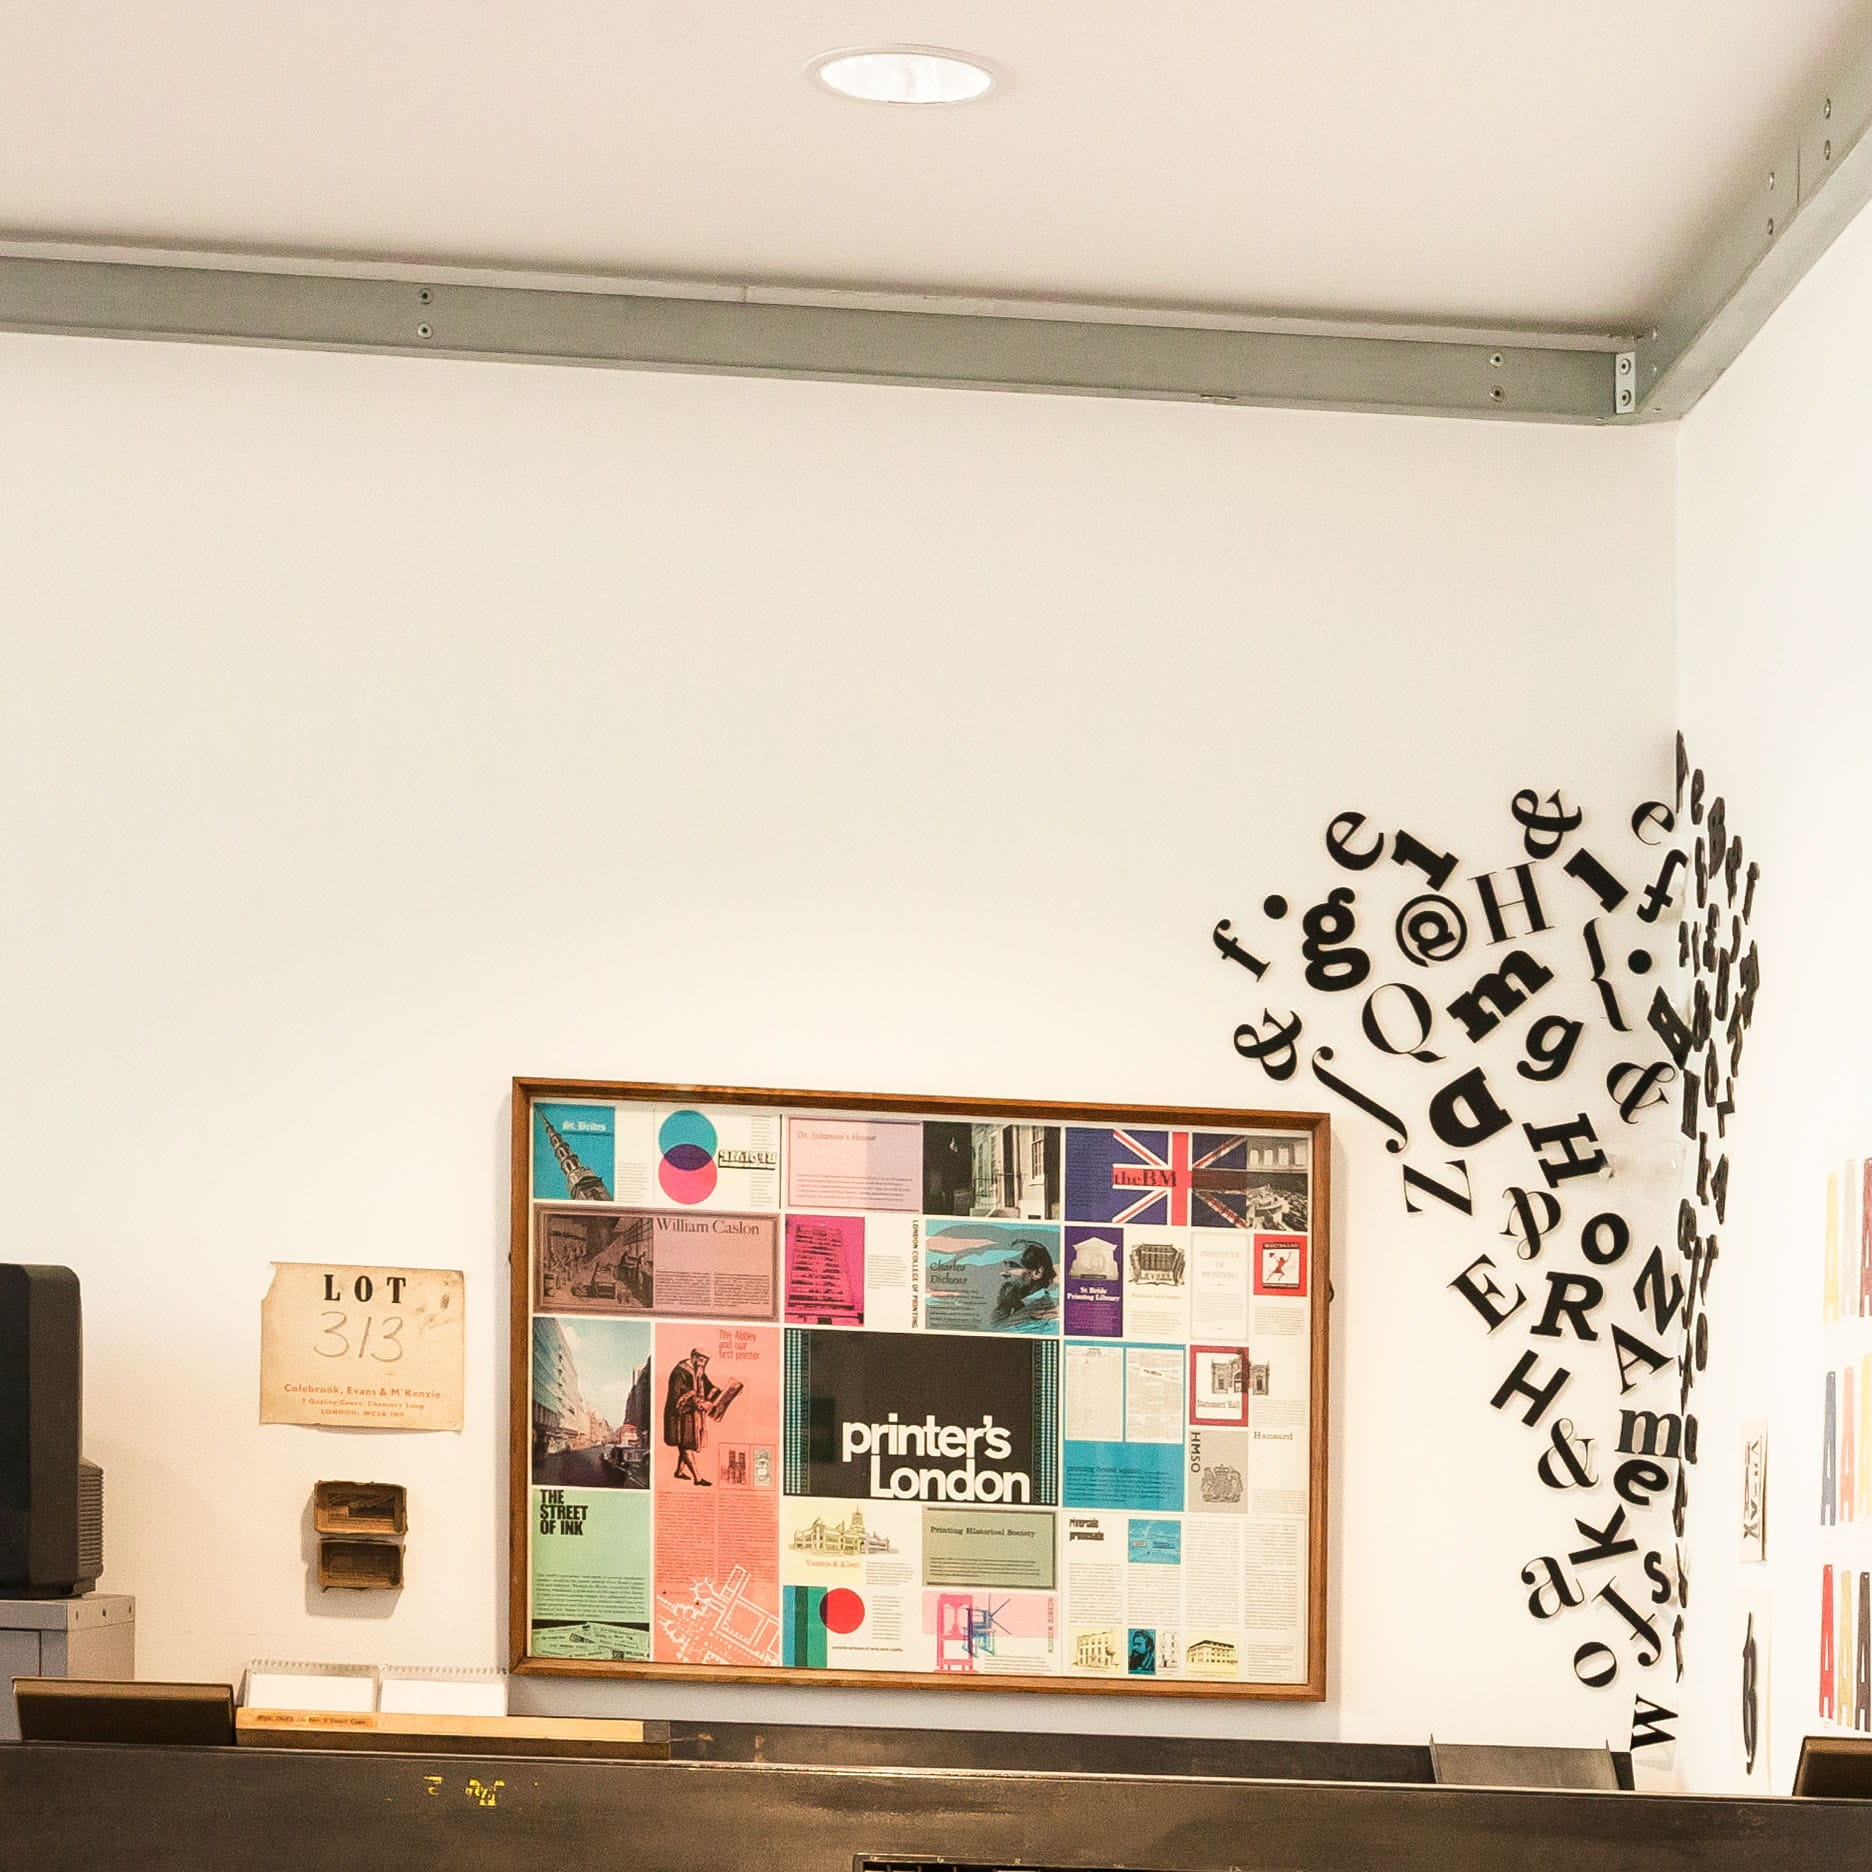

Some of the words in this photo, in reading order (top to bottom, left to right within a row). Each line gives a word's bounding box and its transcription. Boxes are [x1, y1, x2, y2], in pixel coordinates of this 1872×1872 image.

[656, 1217, 710, 1233] William
[712, 1219, 761, 1236] Caslon
[929, 1262, 967, 1273] Charles
[929, 1273, 968, 1285] Dickens
[323, 1273, 407, 1304] LOT
[314, 1311, 404, 1363] 313
[347, 1386, 376, 1397] Evans
[379, 1386, 387, 1397] &
[841, 1412, 1013, 1463] printer's
[1253, 1431, 1294, 1441] Hansard
[1189, 1431, 1202, 1473] HMSO
[869, 1454, 1031, 1504] London
[539, 1488, 565, 1505] THE
[539, 1503, 589, 1521] STREET
[539, 1519, 557, 1535] OF
[559, 1519, 584, 1536] INK
[929, 1525, 964, 1536] Printing
[965, 1526, 1005, 1537] Historical
